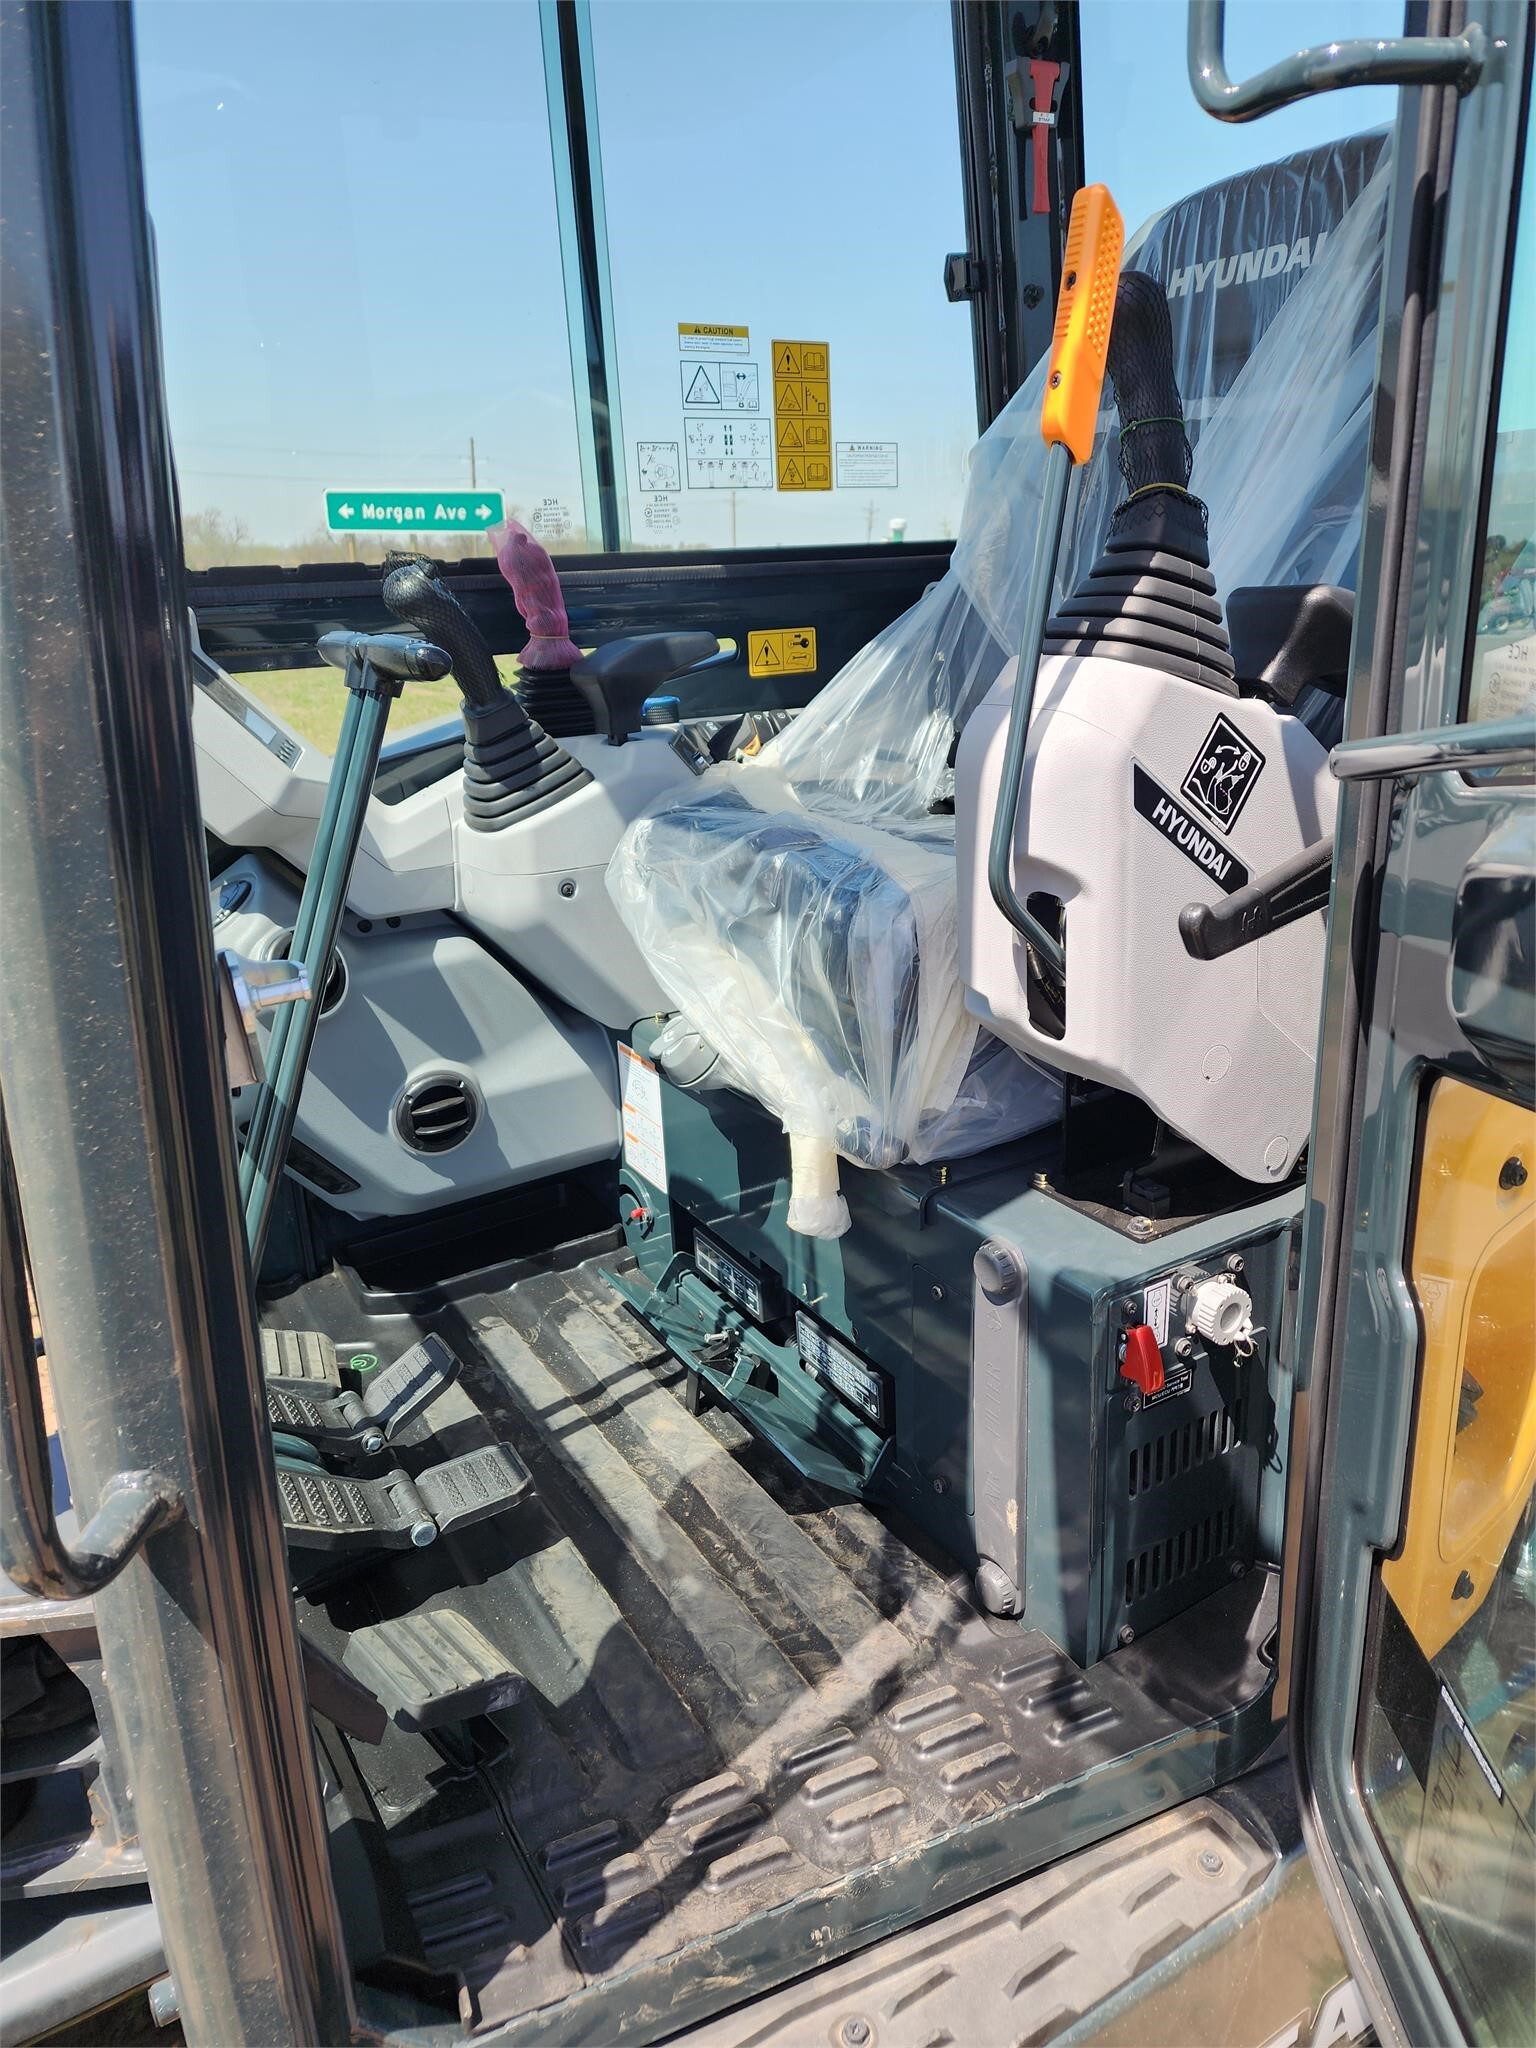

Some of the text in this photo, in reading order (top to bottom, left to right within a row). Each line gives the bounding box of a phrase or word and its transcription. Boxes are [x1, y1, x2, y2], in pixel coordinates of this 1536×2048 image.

[703, 326, 734, 336] CAUTION
[361, 503, 467, 524] Morgan Ave
[1151, 797, 1232, 880] HYUNDAI
